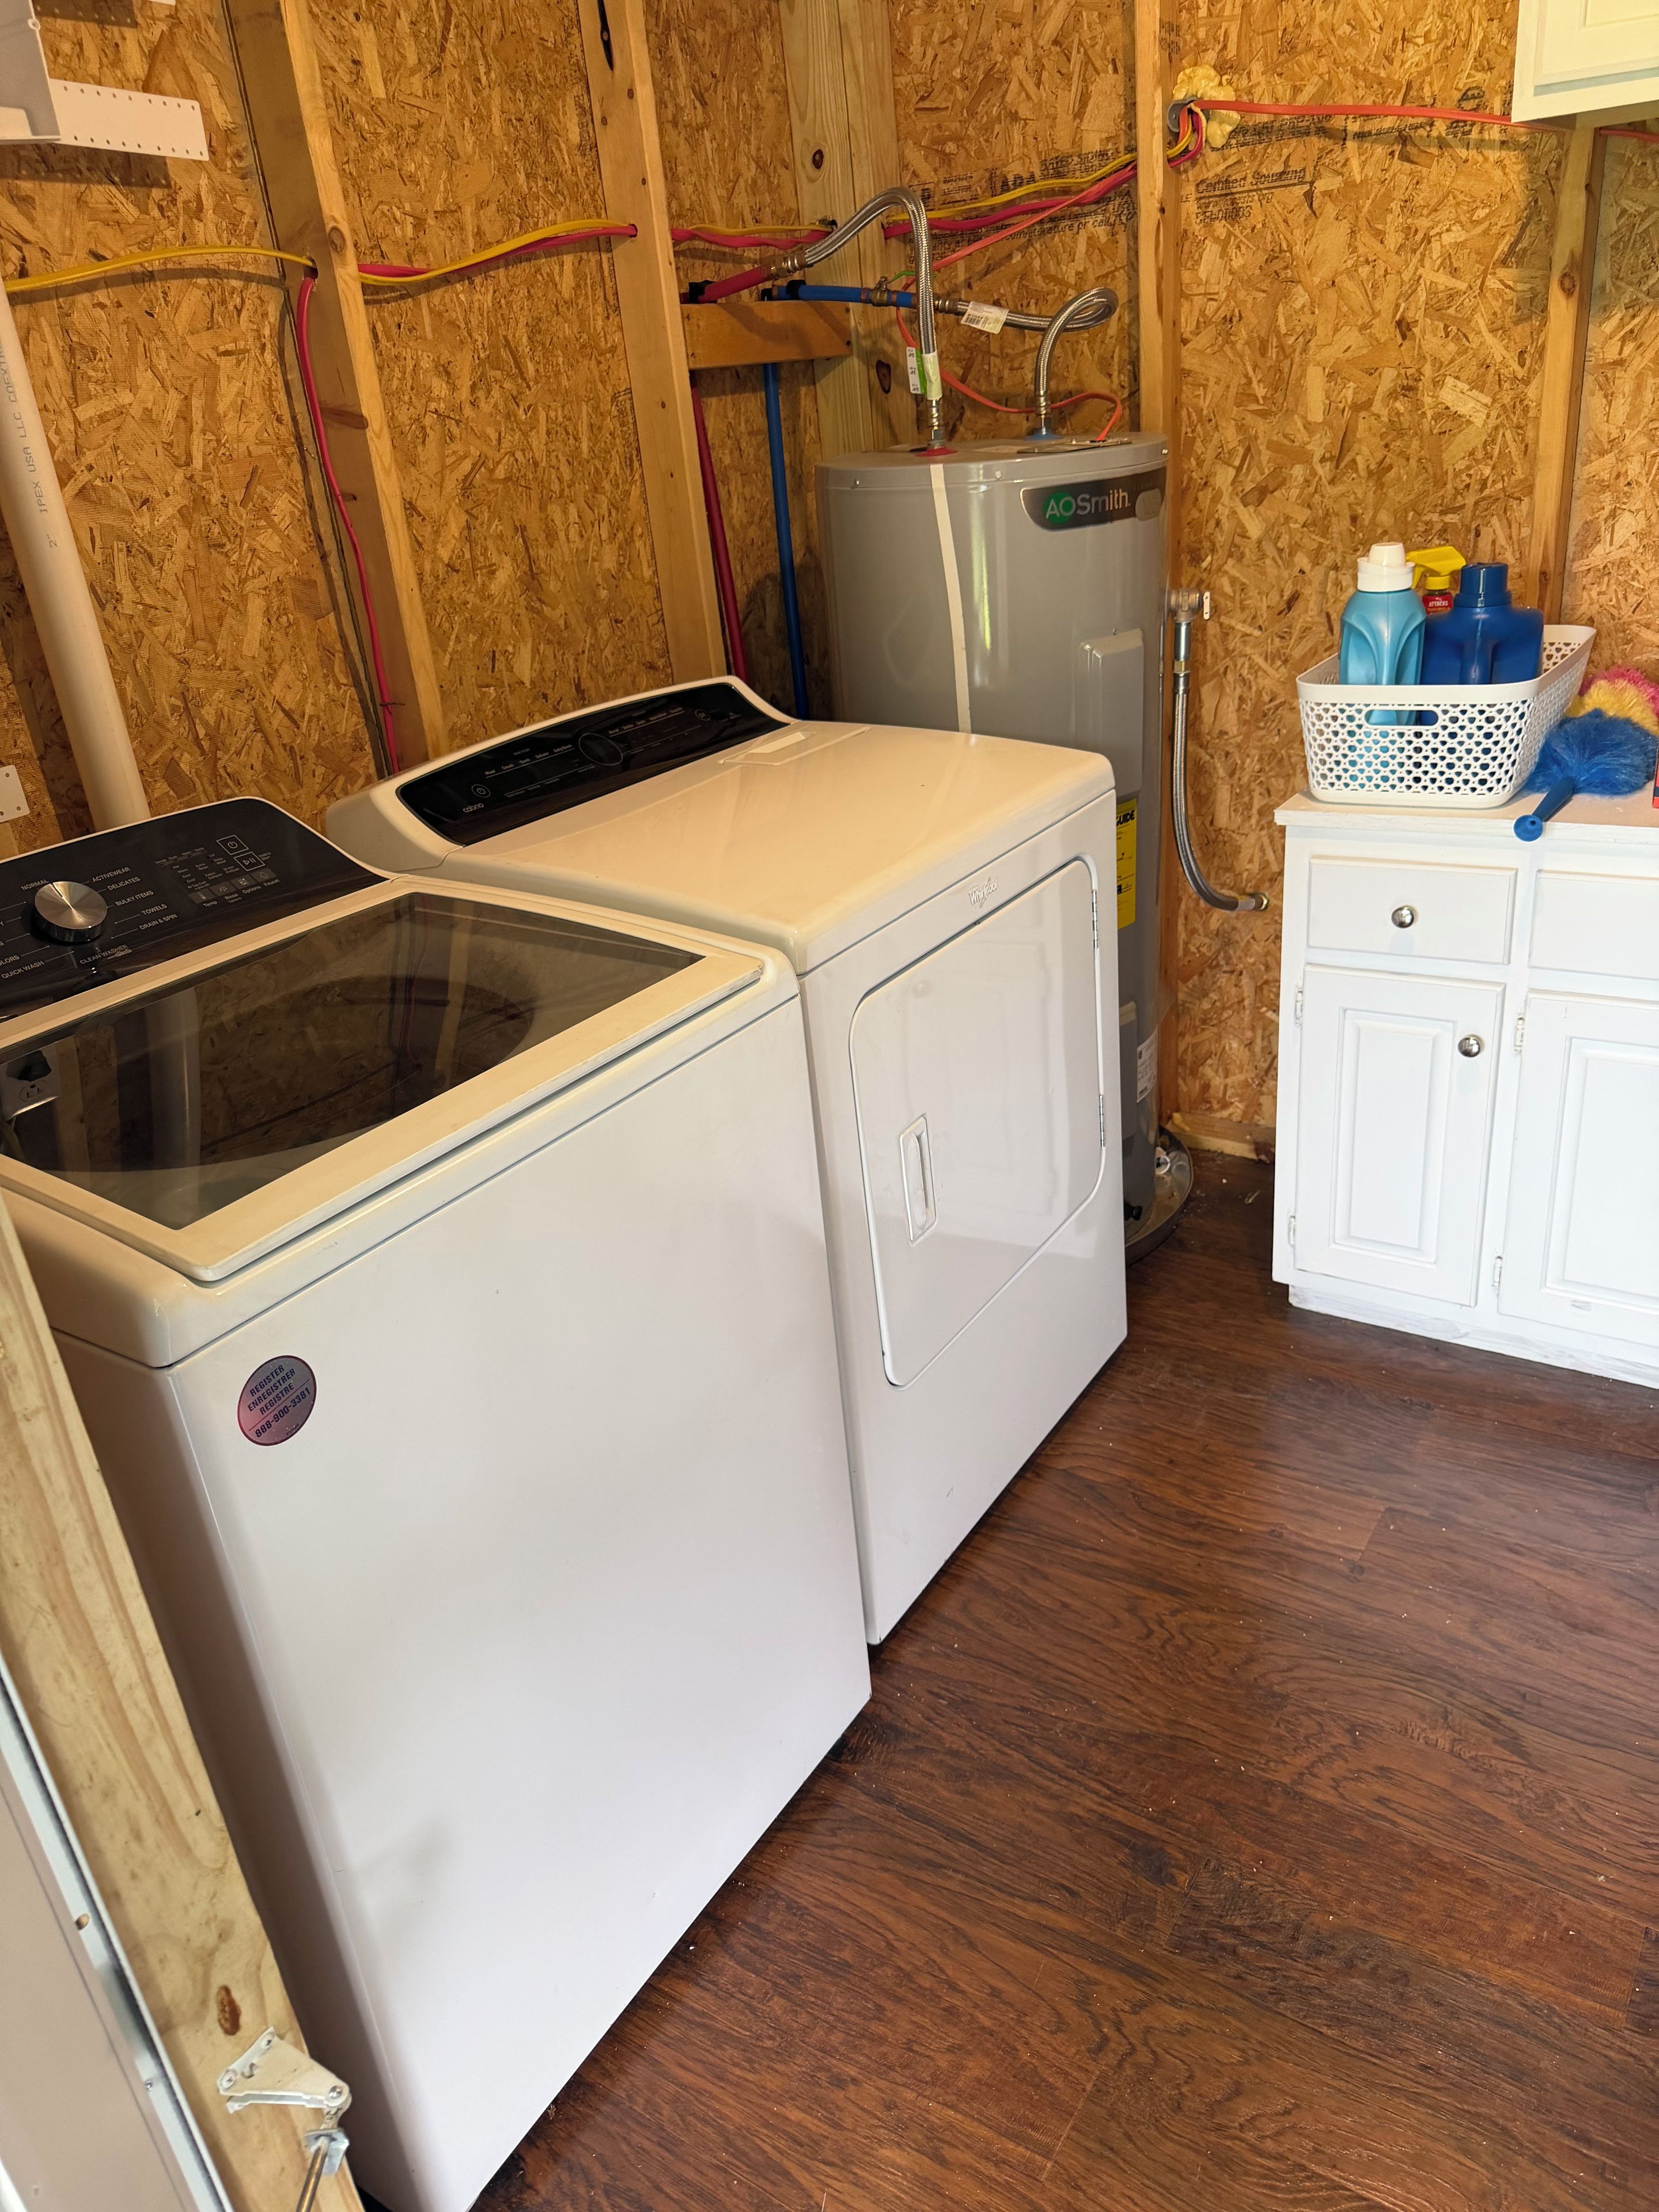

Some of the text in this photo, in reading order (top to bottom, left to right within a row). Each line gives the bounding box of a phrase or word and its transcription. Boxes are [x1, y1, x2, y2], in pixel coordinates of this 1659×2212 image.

[14, 411, 28, 438] LLC
[24, 446, 37, 473] USA
[33, 481, 48, 513] IPEX
[92, 866, 131, 882] ACTIVEWEAR
[107, 877, 141, 891] DELICATES
[21, 879, 50, 891] NORMAL
[242, 886, 262, 895] Options
[115, 890, 154, 906] BULKY ITEMS
[141, 904, 168, 916] TOWELS
[139, 920, 158, 930] DRAIN
[163, 914, 178, 922] SPIN
[79, 953, 101, 965] CLEAN
[101, 944, 129, 957] WASHER
[1, 960, 44, 979] QUICK WASH
[248, 1368, 296, 1411] ENREGISTRER
[250, 1365, 285, 1397] REGISTER
[259, 1382, 294, 1415] REGISTRE
[255, 1387, 310, 1438] 888-900-3381
